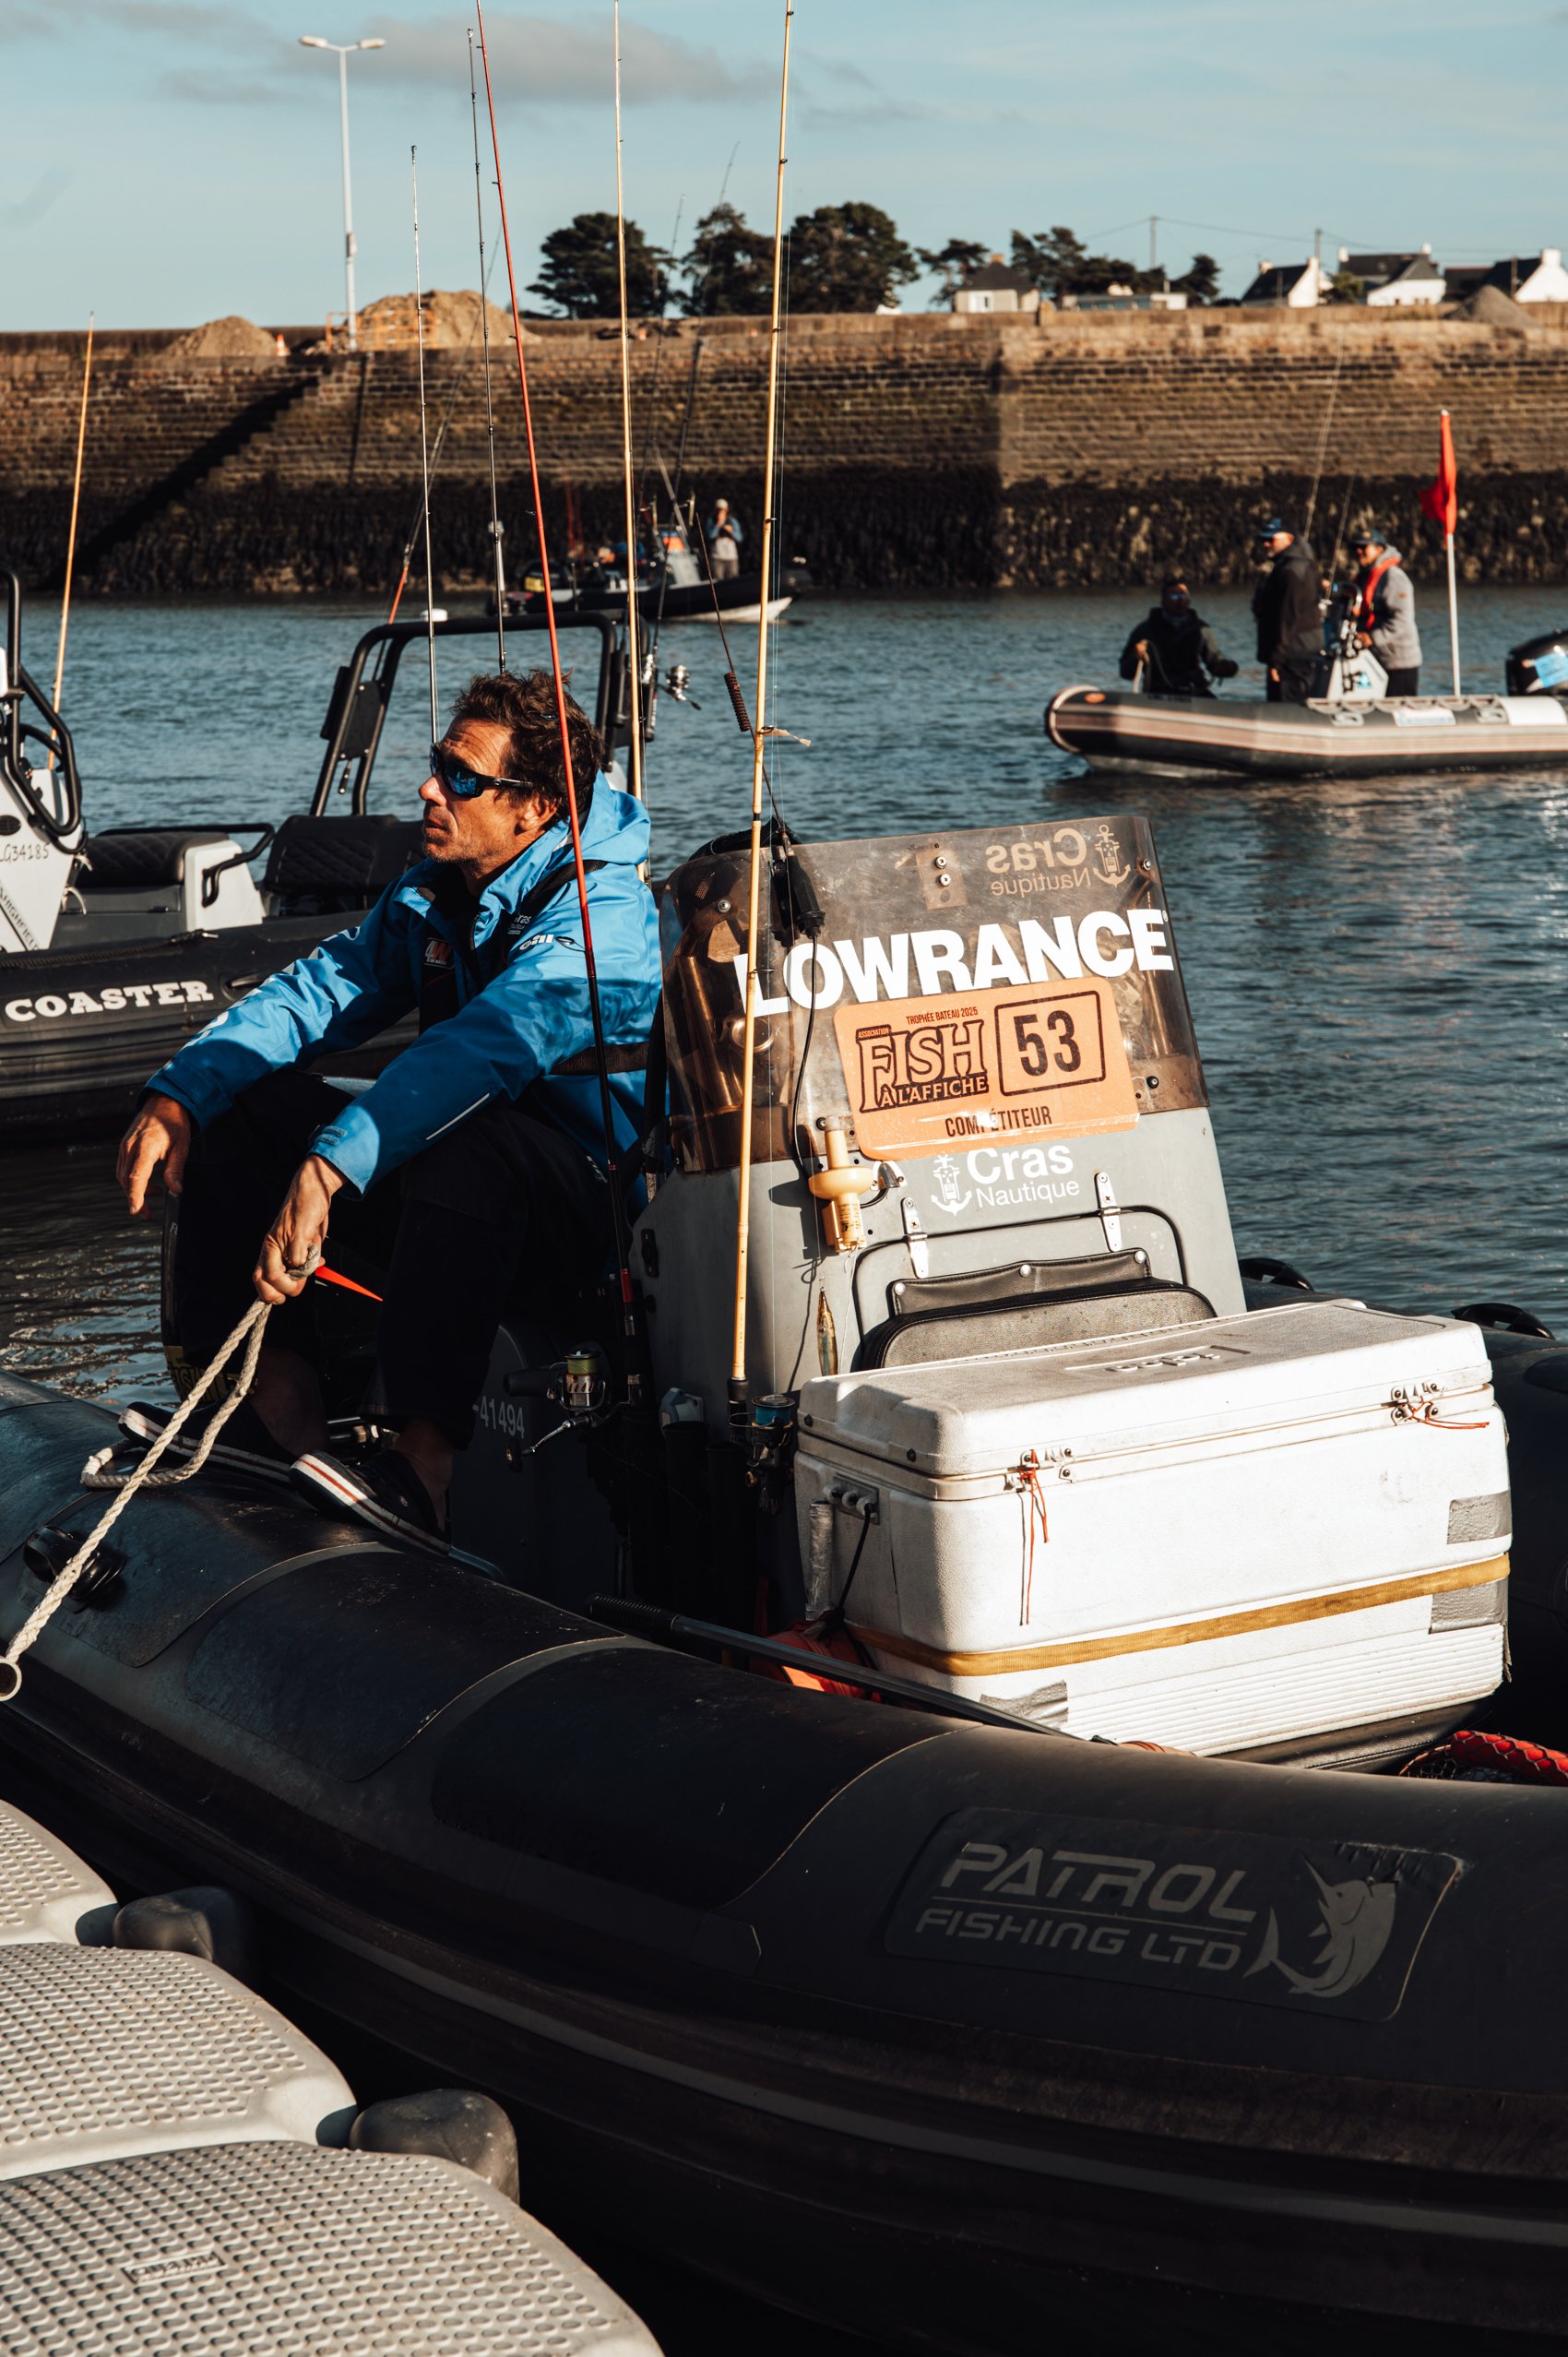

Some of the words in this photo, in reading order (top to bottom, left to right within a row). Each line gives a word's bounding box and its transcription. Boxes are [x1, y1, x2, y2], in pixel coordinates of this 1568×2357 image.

[0, 843, 50, 863] G34185
[733, 909, 1174, 1018] LOWRANCE
[5, 981, 214, 1021] COASTER
[906, 1011, 934, 1025] TROPHÉE
[935, 1009, 960, 1021] BATEAU
[961, 1006, 979, 1018] 2025
[1013, 1010, 1081, 1077] 53
[856, 1019, 988, 1113] FISH
[897, 1076, 987, 1104] L'AFFICHE
[945, 1106, 1052, 1137] COMÉTITEUR
[967, 1145, 1074, 1184] Cras
[976, 1180, 1080, 1208] Nautique
[941, 1842, 1257, 1923] PATROL
[915, 1908, 1131, 1955] FISHING
[1140, 1933, 1241, 1970] LTD
